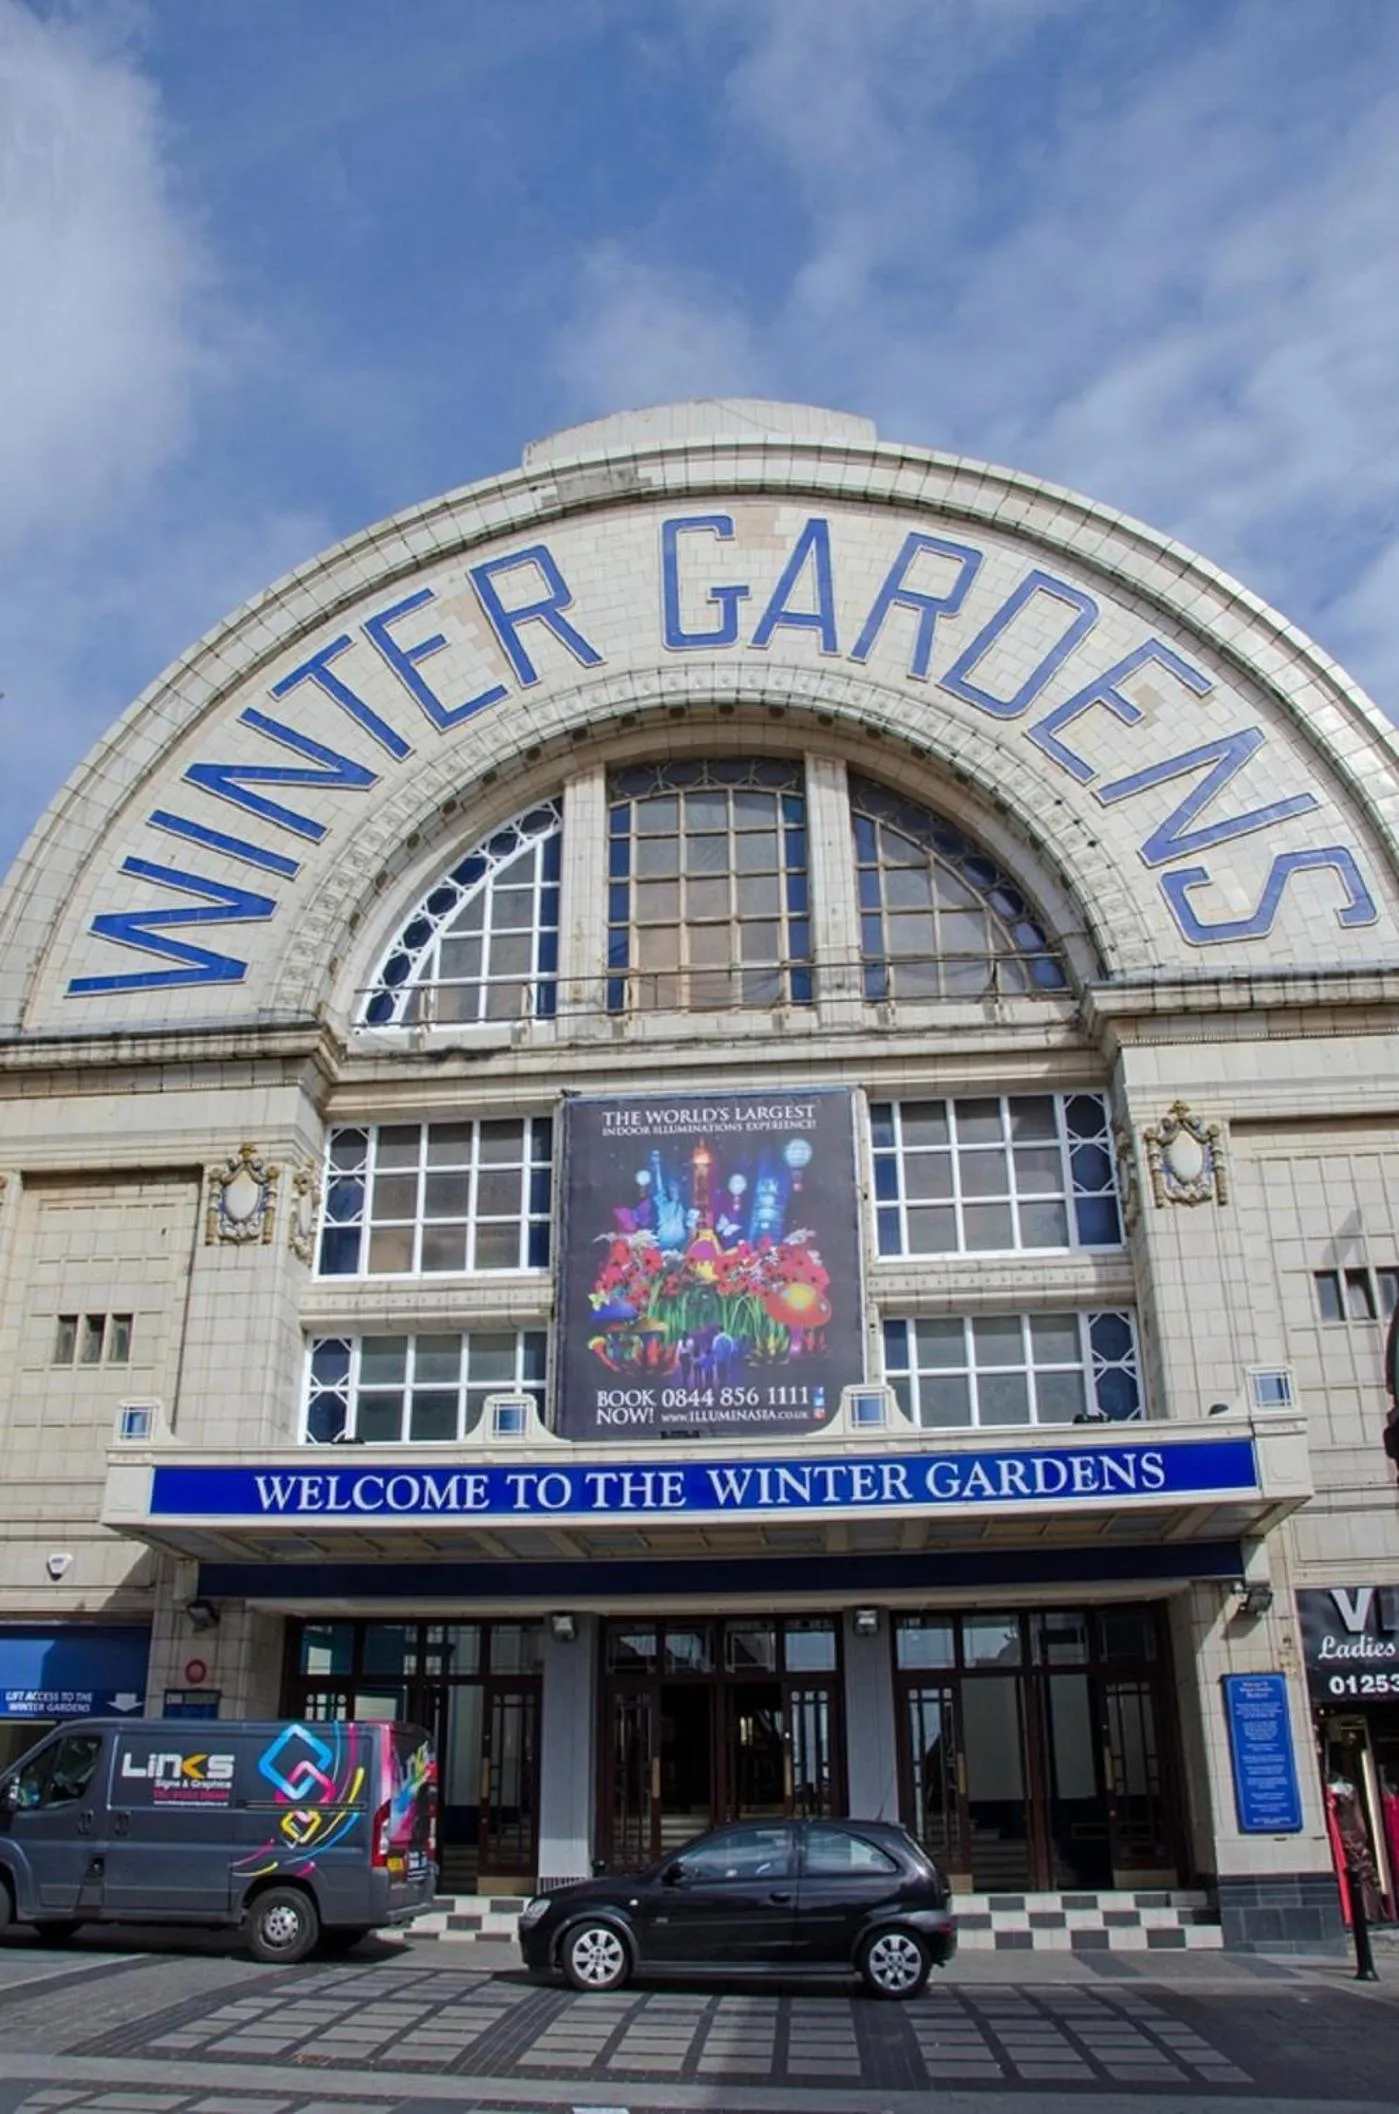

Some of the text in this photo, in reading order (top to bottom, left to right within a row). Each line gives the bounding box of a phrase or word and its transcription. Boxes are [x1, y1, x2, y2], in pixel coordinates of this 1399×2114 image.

[64, 514, 1379, 998] WINTER GARDENS
[603, 1104, 815, 1126] THE WORLD'S LARGEST
[597, 1386, 809, 1407] BOOK 0844 856 1111
[596, 1407, 655, 1425] NOW!
[254, 1452, 1166, 1511] WELCOME TO THE WINTER GARDENS
[1318, 1635, 1396, 1660] Ladies
[1329, 1674, 1399, 1695] 01253
[61, 1692, 75, 1702] TO
[47, 1703, 91, 1713] GARDENS
